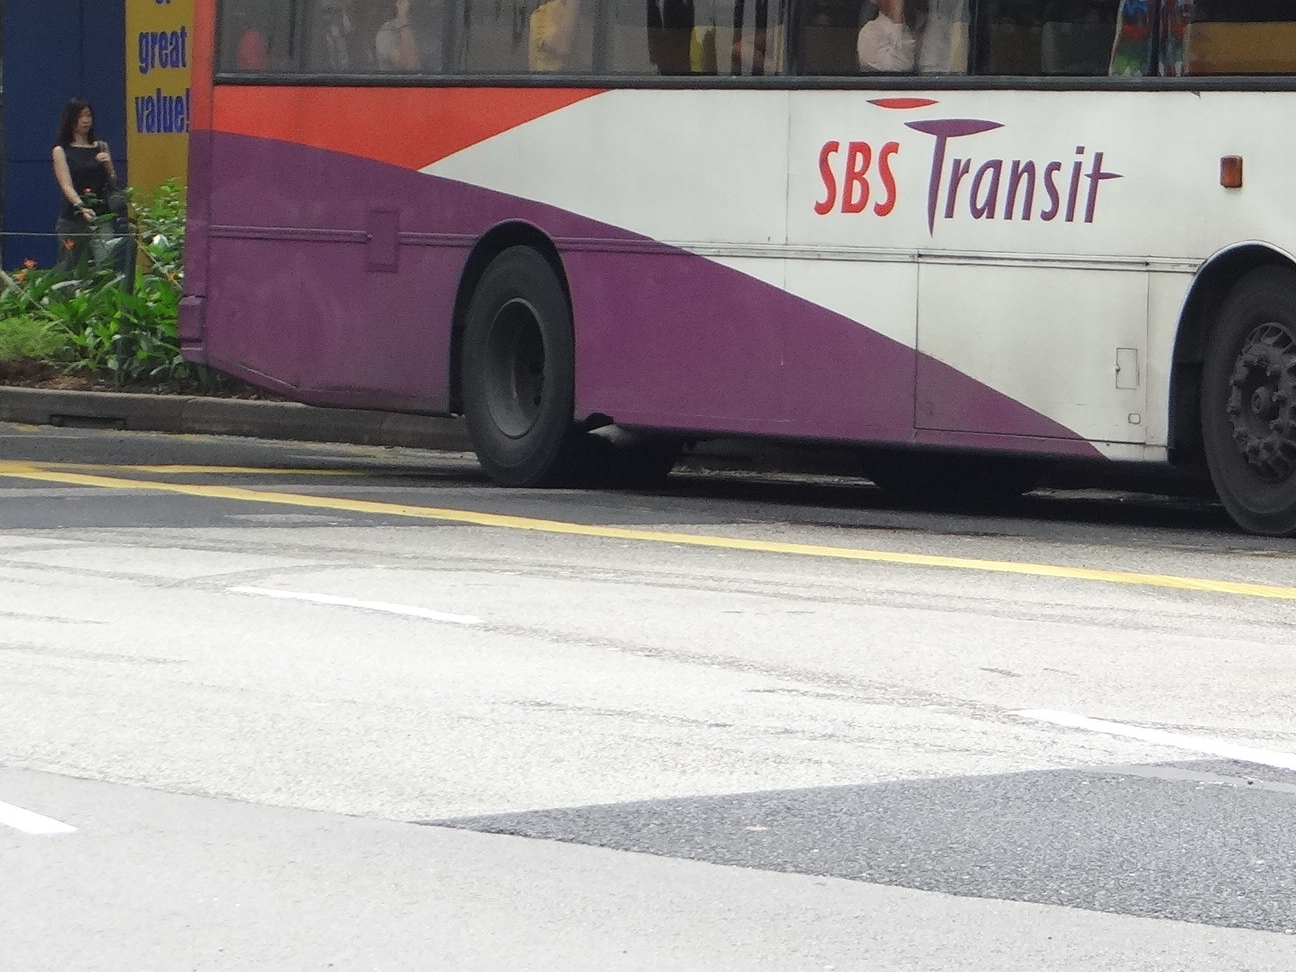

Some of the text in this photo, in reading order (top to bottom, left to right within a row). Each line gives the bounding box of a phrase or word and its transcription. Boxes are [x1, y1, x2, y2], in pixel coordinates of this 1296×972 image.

[138, 26, 187, 75] great
[135, 88, 190, 134] value!
[813, 118, 1125, 238] SBS Transit
